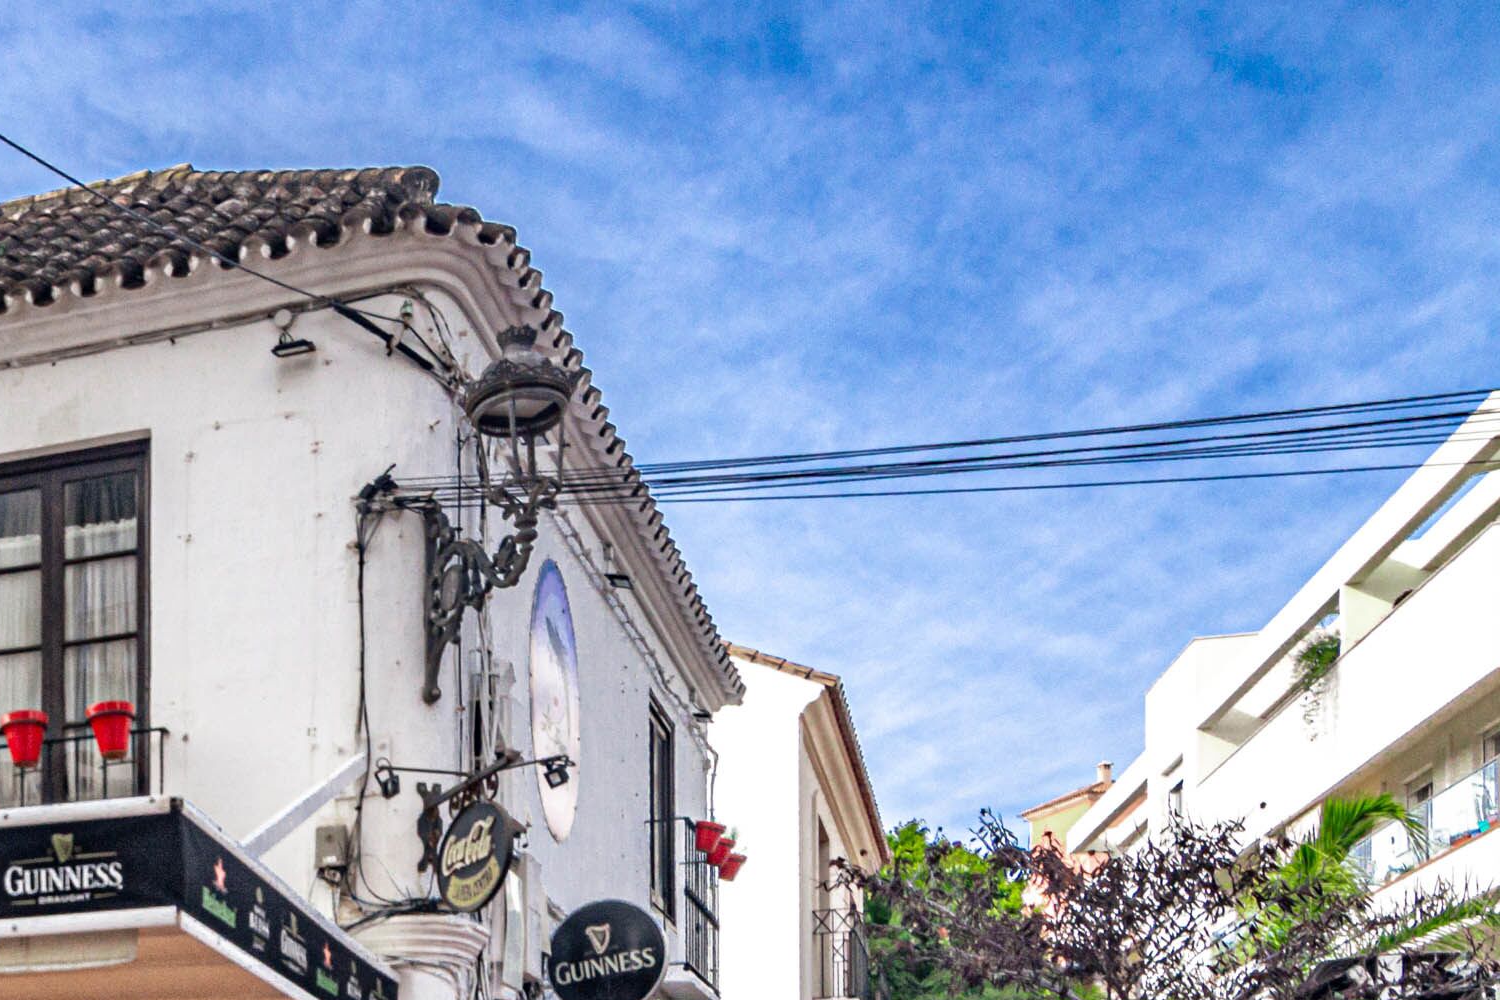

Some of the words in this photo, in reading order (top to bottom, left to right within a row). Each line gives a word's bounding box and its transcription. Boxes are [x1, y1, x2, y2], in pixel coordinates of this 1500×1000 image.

[3, 861, 123, 897] GUINNESS
[37, 892, 92, 905] DRAUGHT
[555, 946, 656, 986] GUINNESS
